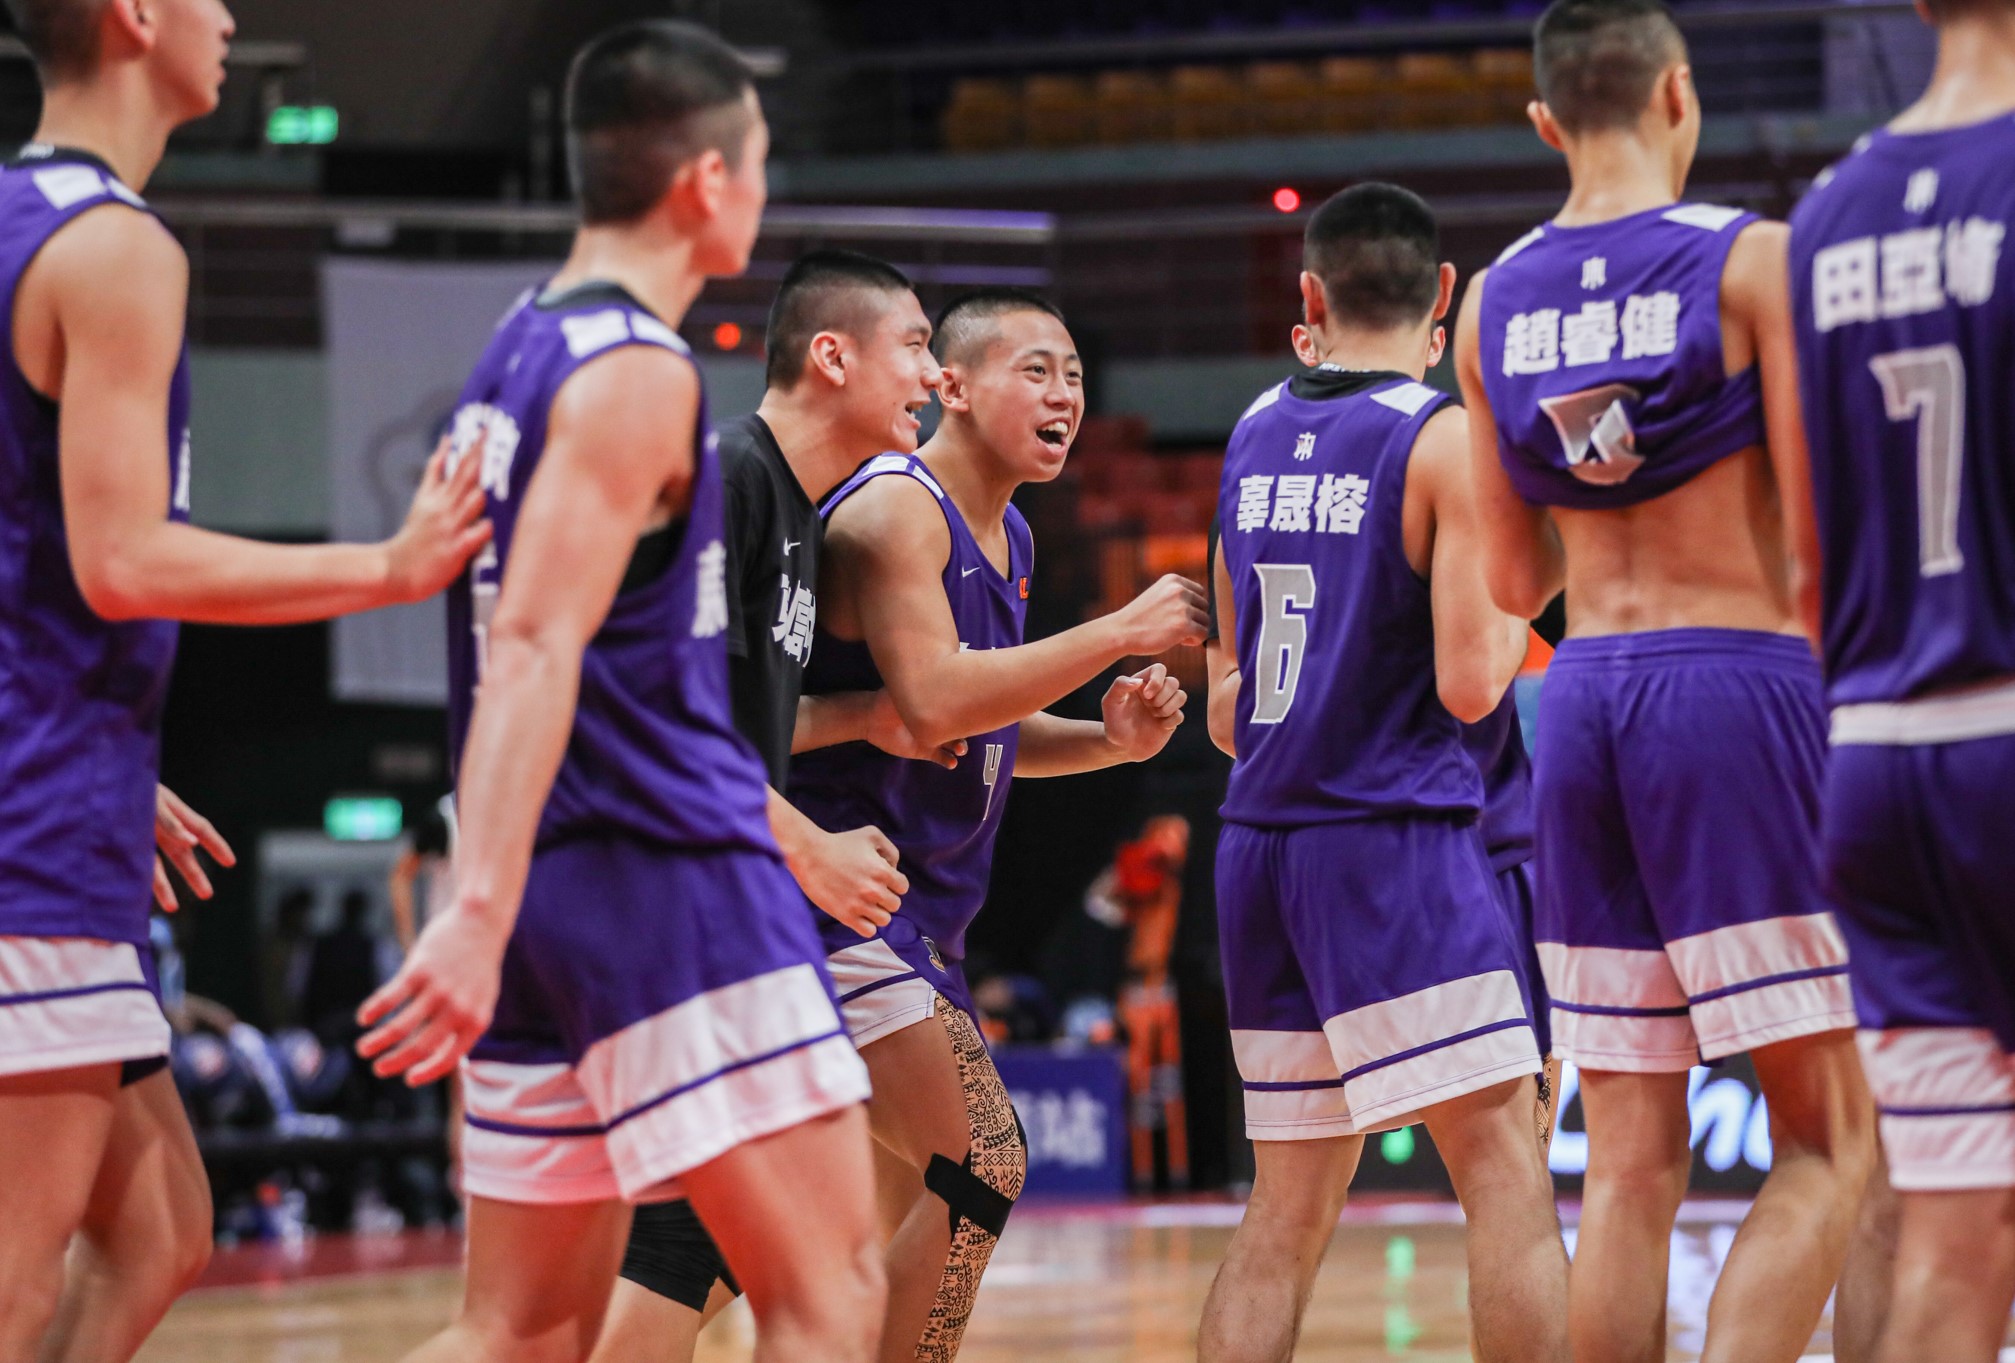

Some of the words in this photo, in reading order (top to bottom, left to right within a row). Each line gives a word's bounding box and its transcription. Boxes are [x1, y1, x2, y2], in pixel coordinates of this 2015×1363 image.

[1502, 291, 1681, 378] 趙睿健
[1236, 473, 1370, 534] 辜晟榕
[1868, 343, 1967, 578] 7
[1250, 563, 1316, 724] 6
[982, 744, 1004, 821] 4
